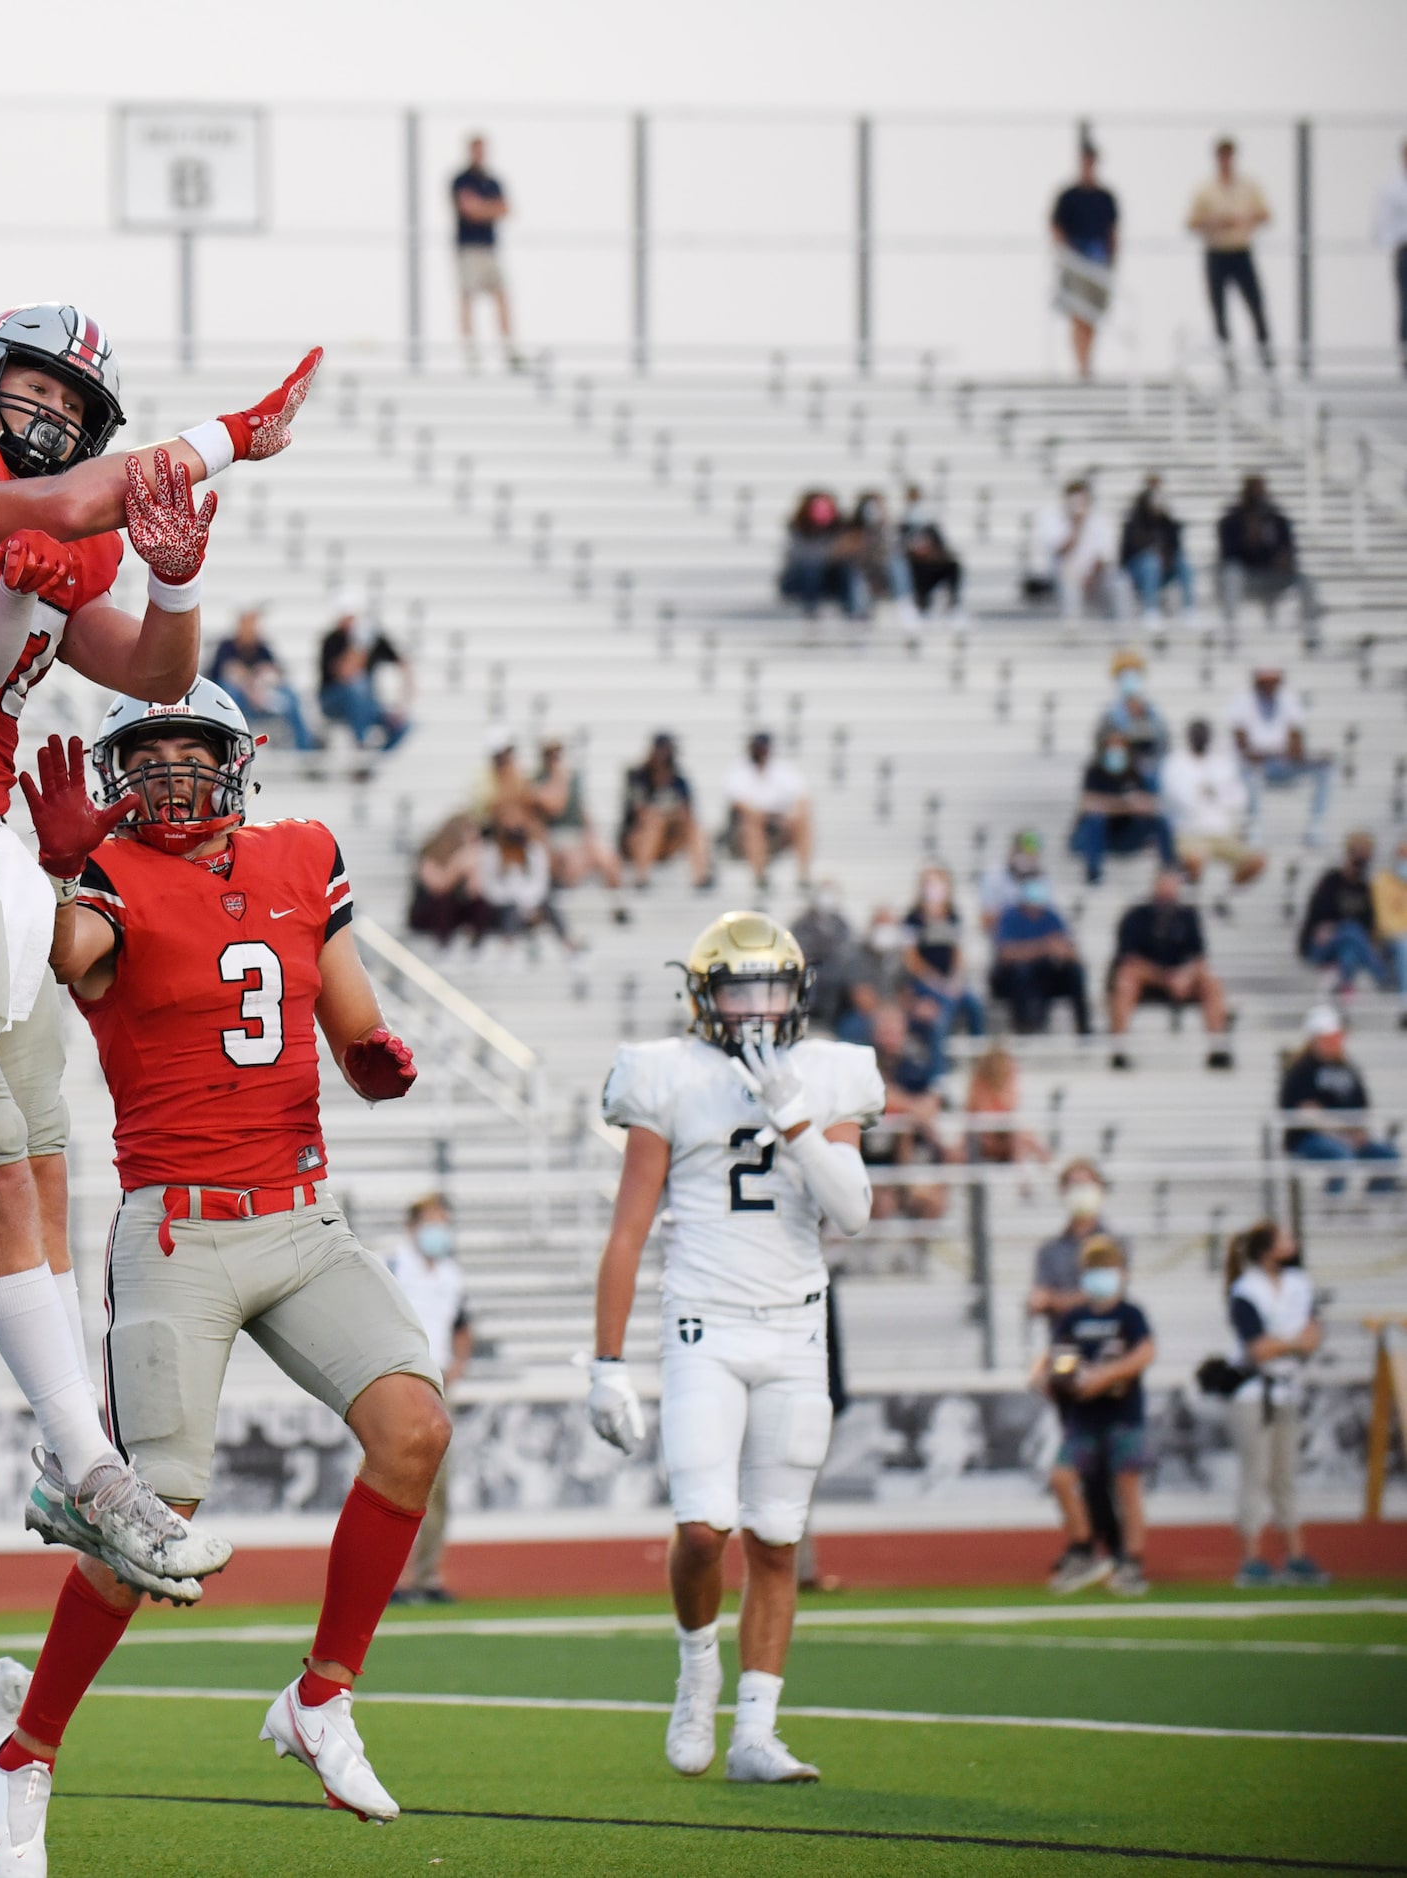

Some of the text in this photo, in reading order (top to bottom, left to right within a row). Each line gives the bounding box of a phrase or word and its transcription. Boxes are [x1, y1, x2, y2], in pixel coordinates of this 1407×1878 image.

[167, 156, 216, 211] B
[147, 706, 190, 717] Riddell
[218, 940, 284, 1067] 3
[729, 1128, 775, 1211] 2
